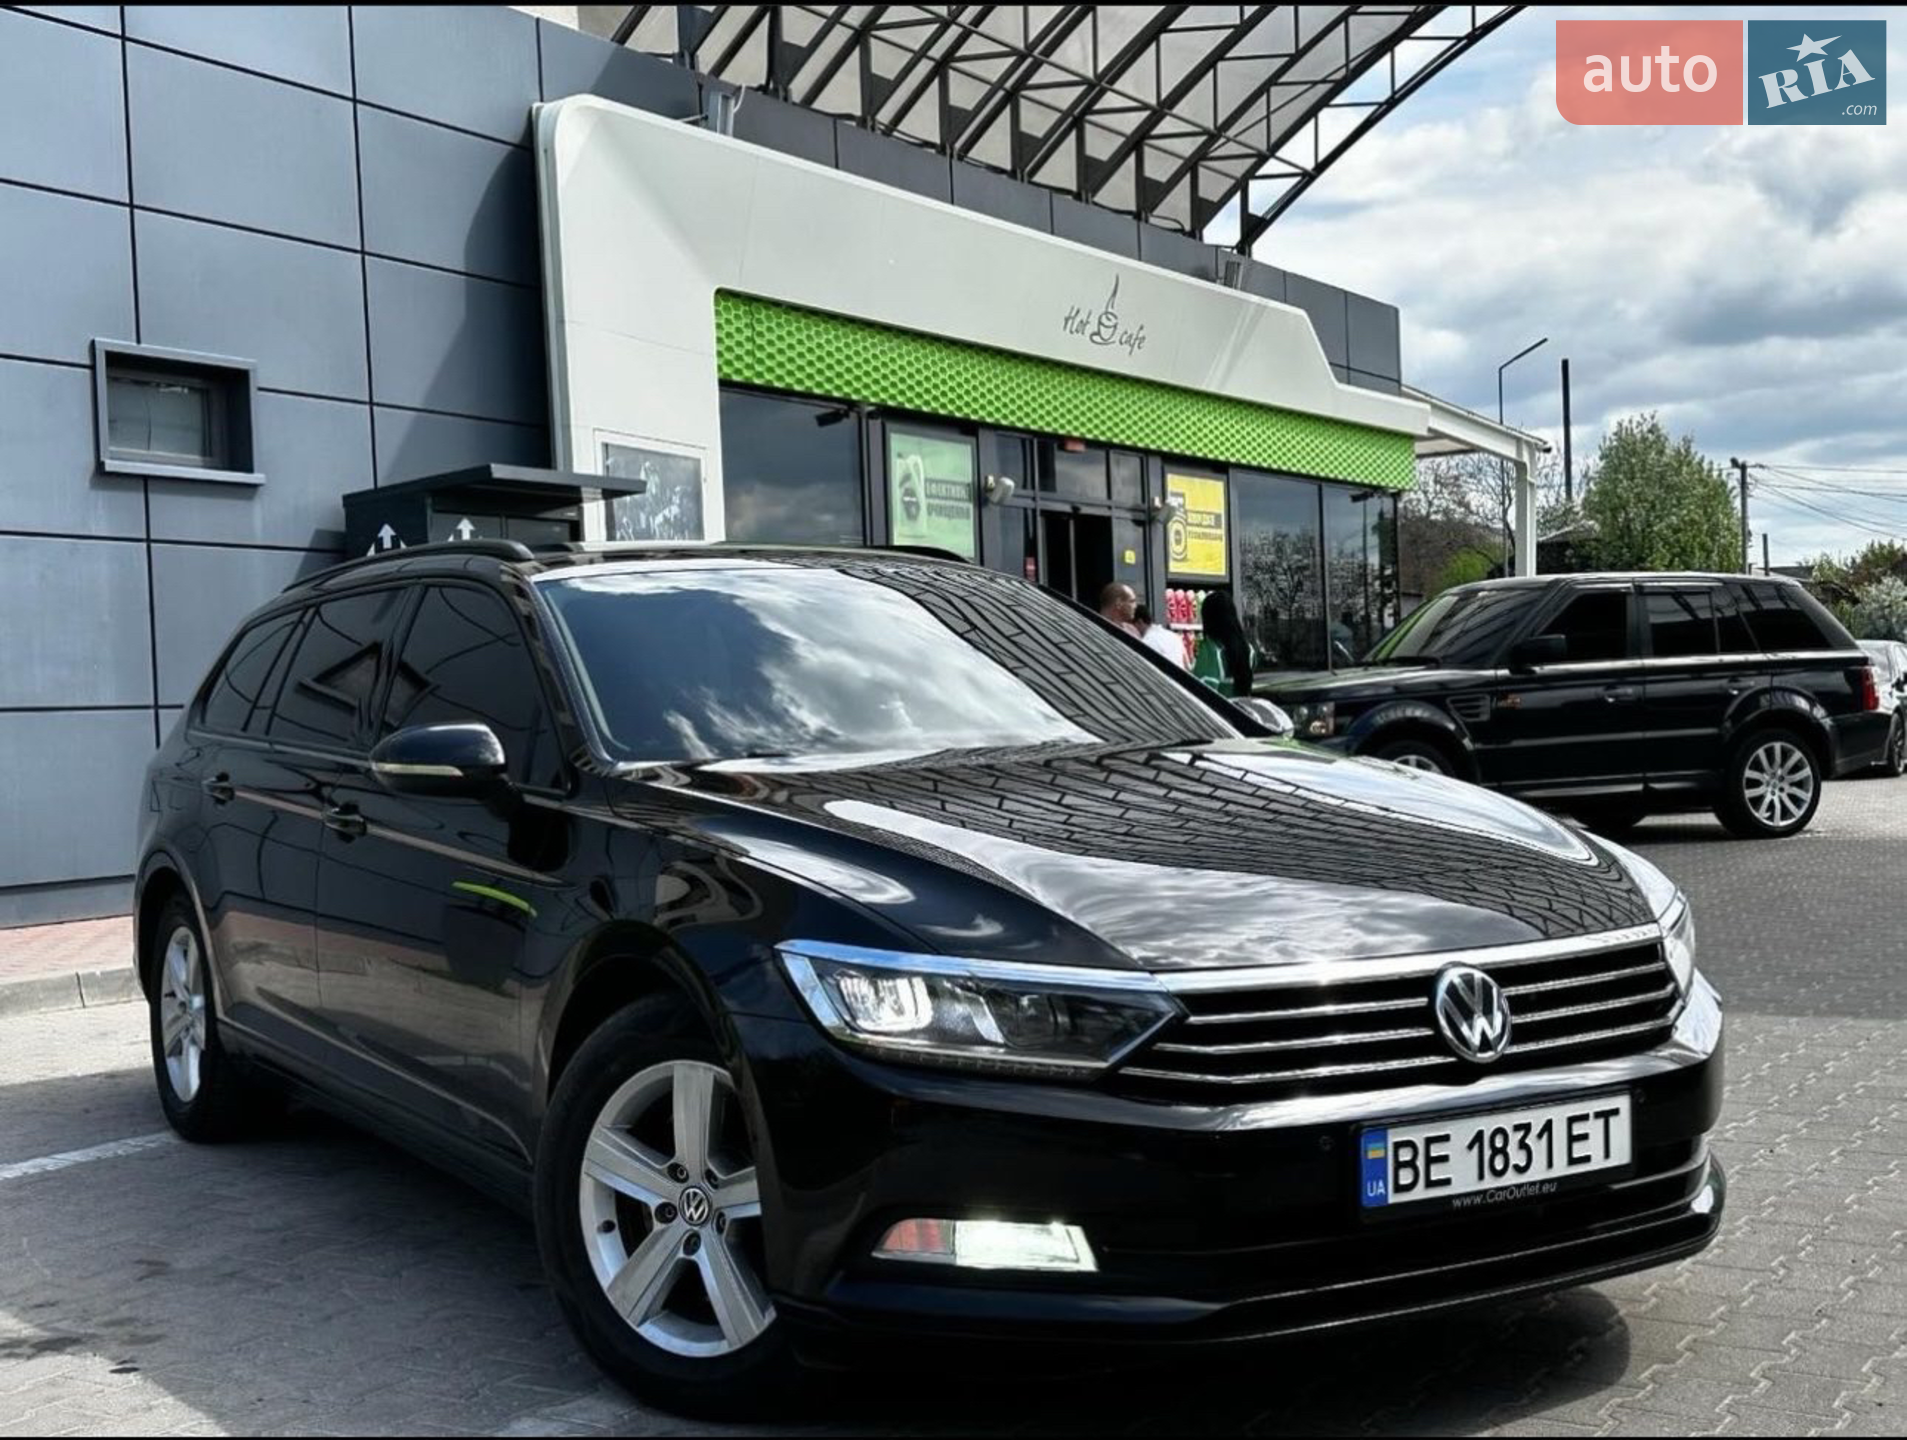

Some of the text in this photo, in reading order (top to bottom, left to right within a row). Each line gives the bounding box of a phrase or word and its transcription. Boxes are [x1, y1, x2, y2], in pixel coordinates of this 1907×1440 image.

[1063, 305, 1093, 335] Hot
[1392, 1107, 1620, 1194] BE 1831 ET
[1367, 1181, 1386, 1197] UA
[1452, 1181, 1558, 1208] www.CarOutlet.eu
